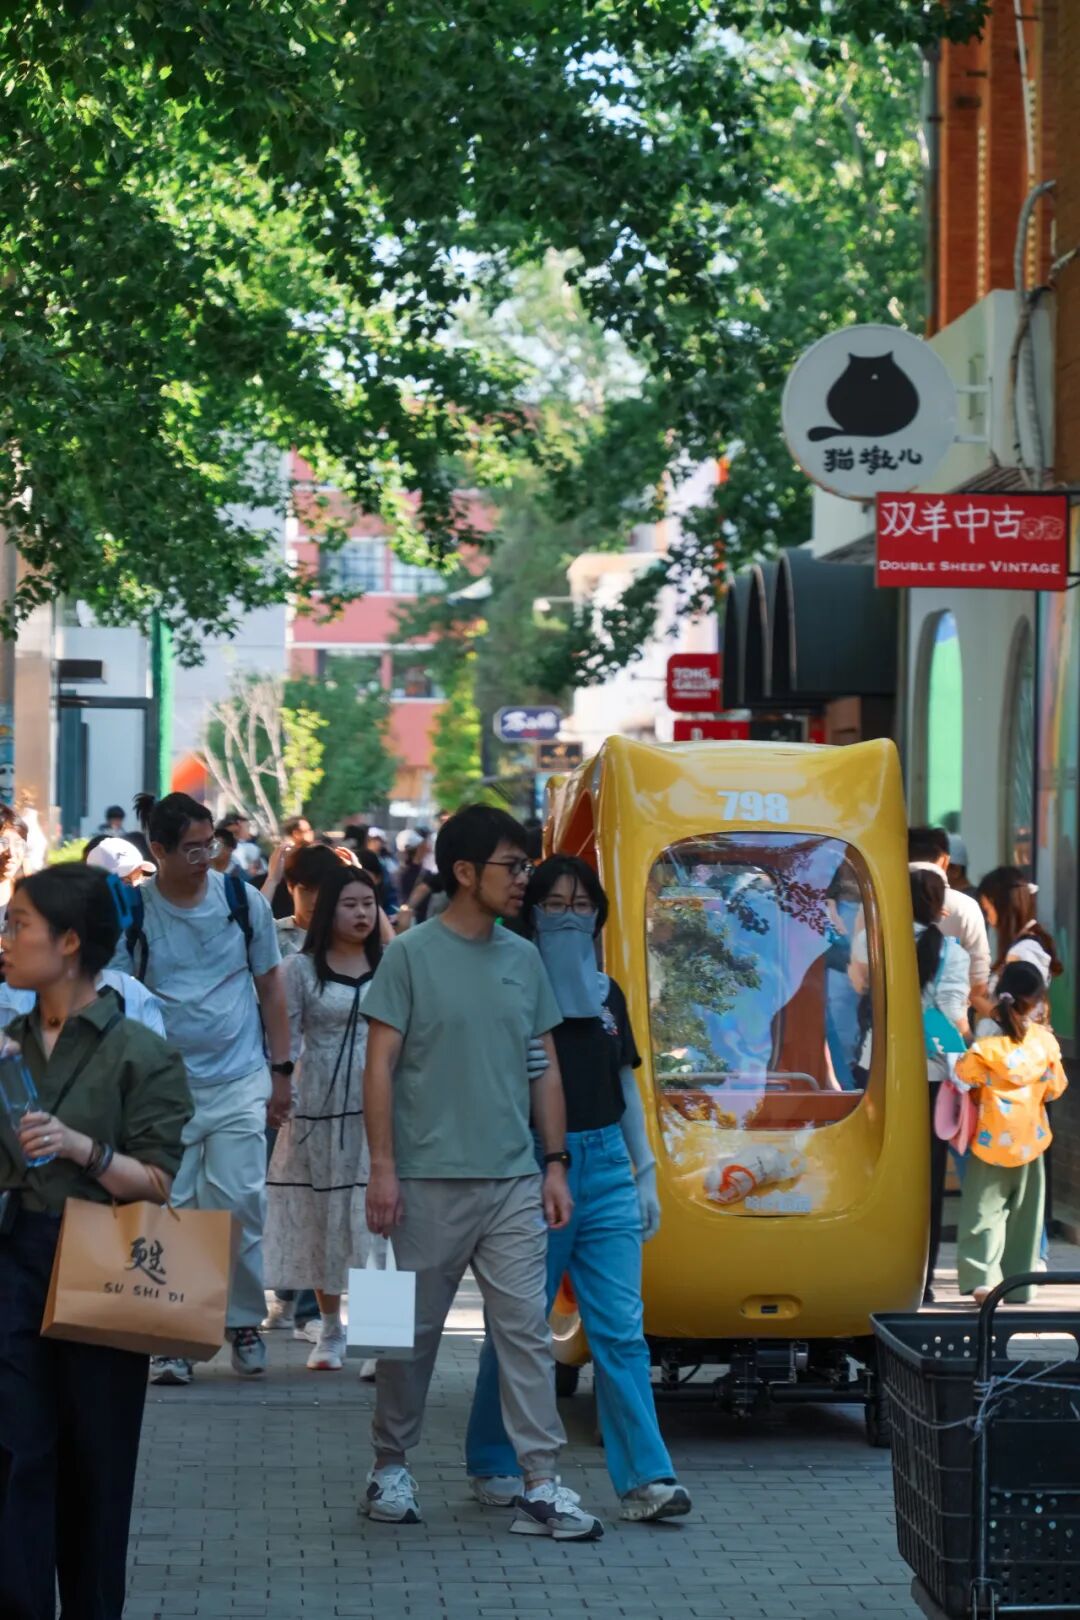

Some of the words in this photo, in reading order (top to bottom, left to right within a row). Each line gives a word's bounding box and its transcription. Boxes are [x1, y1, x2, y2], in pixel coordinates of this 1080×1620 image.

[823, 445, 922, 475] 猫墩儿
[880, 500, 1024, 544] 双羊中古
[879, 560, 935, 571] DOUBLE
[940, 560, 985, 572] SHEEP
[990, 560, 1060, 574] VINTAGE
[672, 679, 721, 690] GALLER
[718, 791, 789, 823] 798
[103, 1282, 124, 1293] SU
[133, 1286, 159, 1298] SHI
[169, 1292, 185, 1303] DI
